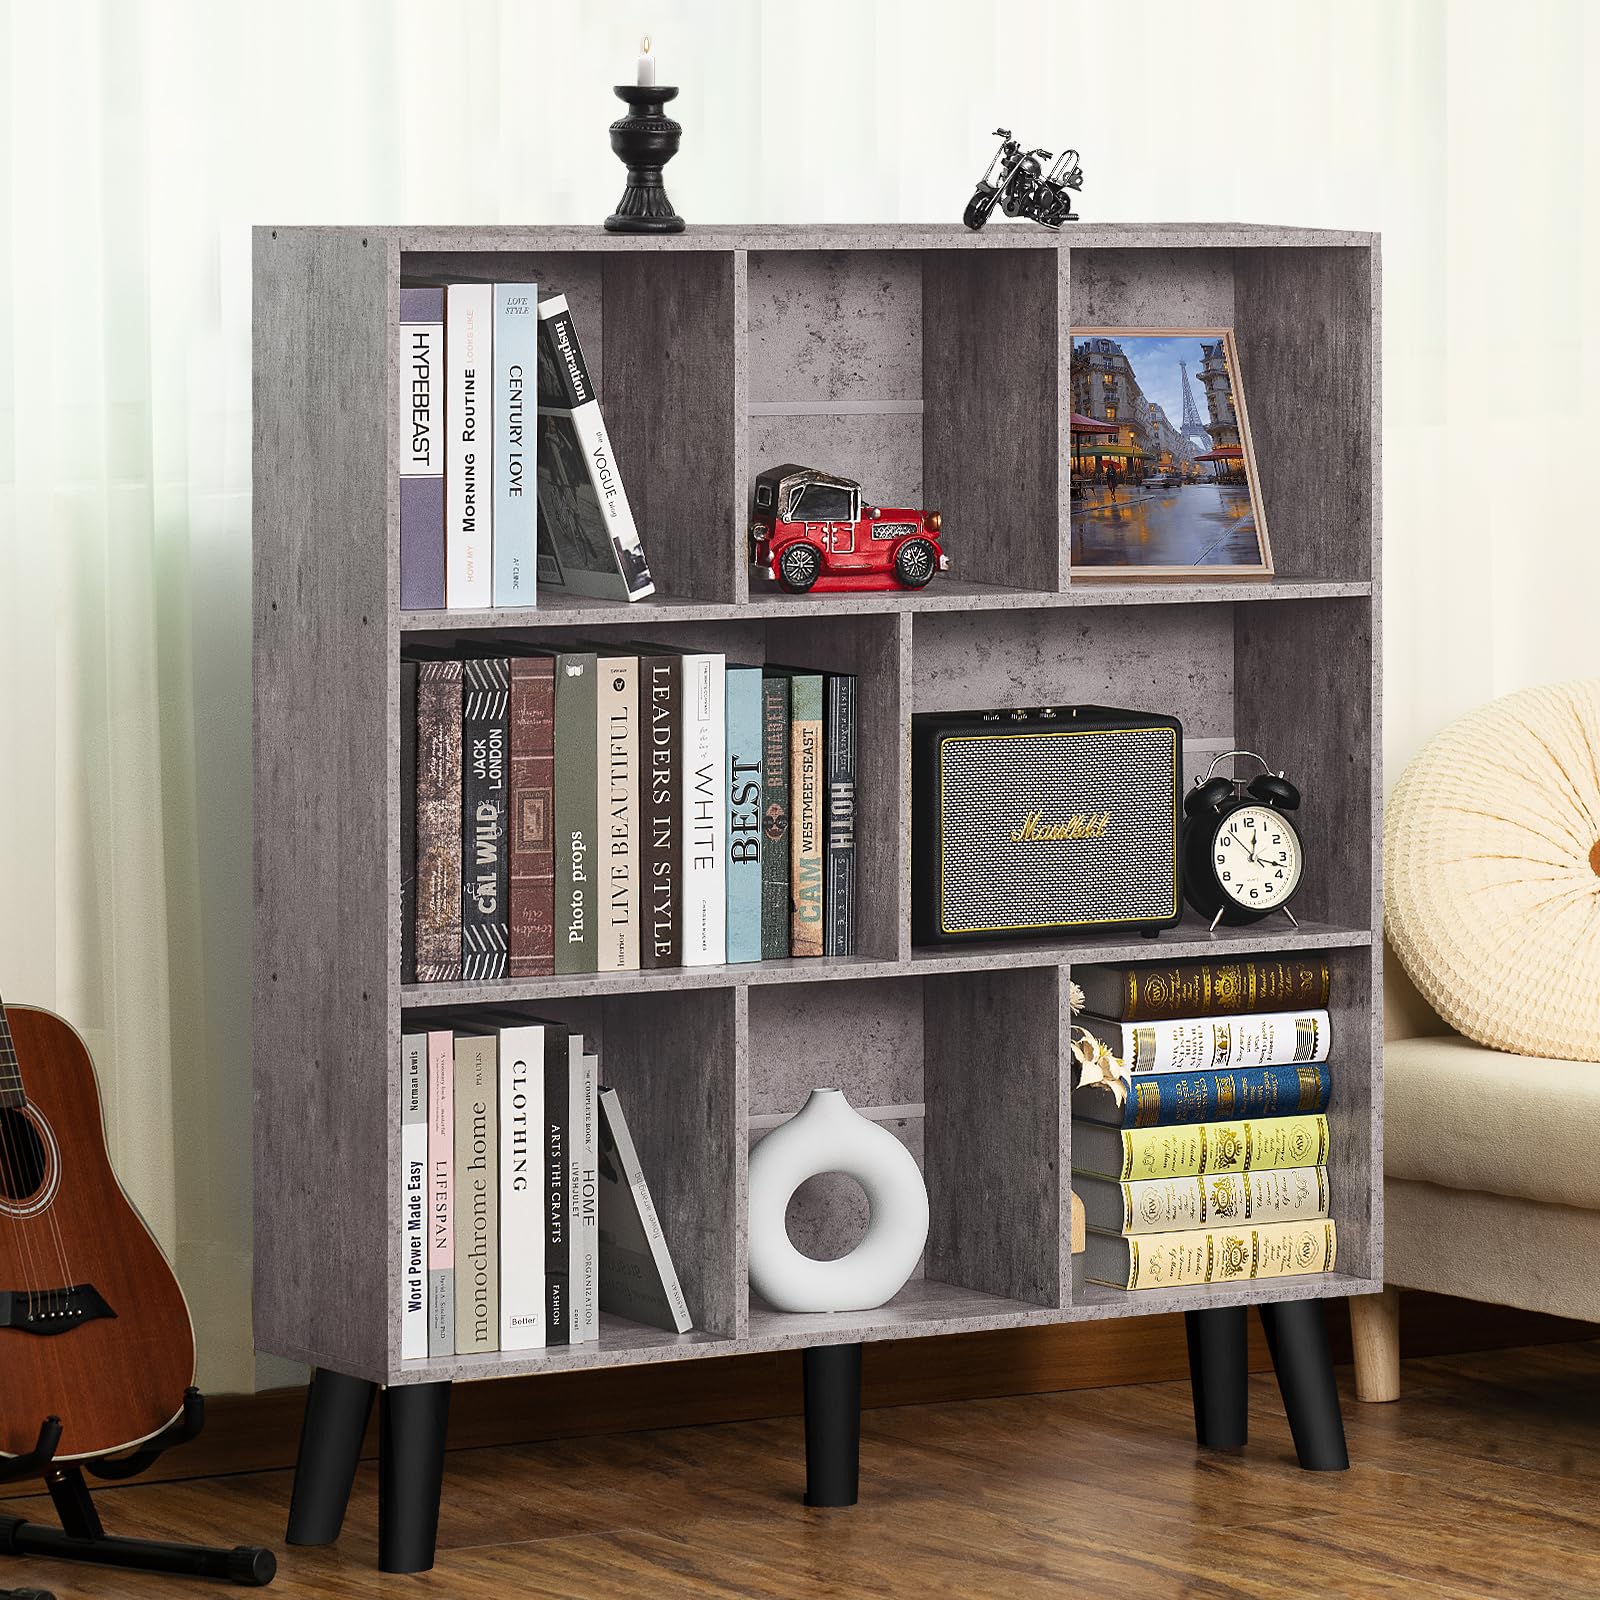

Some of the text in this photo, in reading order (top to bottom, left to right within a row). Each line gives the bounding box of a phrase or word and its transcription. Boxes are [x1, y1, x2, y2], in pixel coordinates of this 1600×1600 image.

[505, 306, 530, 315] STYLE
[507, 297, 528, 306] LOVE
[466, 329, 474, 364] LOOKS
[554, 320, 587, 402] inspiration
[412, 333, 430, 467] HYPEBEAST
[462, 369, 475, 443] ROUTINE
[509, 365, 523, 497] CENTURY LOVE
[462, 453, 475, 532] MORNING
[593, 431, 618, 519] the VOGUE blog
[473, 739, 486, 780] JACK
[489, 729, 503, 790] LONDON
[476, 804, 498, 865] WILD
[610, 706, 629, 967] Interior LIVE BEAUTIFUL
[652, 666, 672, 957] LEADERS IN STYLE
[693, 763, 715, 871] WHITE
[731, 753, 762, 865] BEST
[799, 728, 822, 923] CAM WESTMEETSEAST
[831, 782, 854, 850] HOTH
[1230, 822, 1238, 833] 11
[1243, 817, 1255, 828] 12
[1263, 821, 1267, 832] 1
[1216, 854, 1225, 865] 9
[1220, 836, 1231, 847] 10
[1271, 834, 1281, 844] 2
[1278, 851, 1287, 862] 3
[476, 872, 498, 914] CAL
[569, 831, 587, 944] Photo props
[1222, 871, 1231, 881] 8
[1235, 883, 1244, 894] 7
[1249, 888, 1259, 899] 6
[1264, 882, 1274, 893] 5
[1274, 869, 1284, 879] 4
[1153, 983, 1161, 1002] RW
[512, 1060, 527, 1192] CLOTHING
[1296, 1135, 1303, 1151] RW
[407, 1050, 424, 1313] Word Power Made Easy Norman Lewis
[435, 1161, 448, 1250] LIFESPAN
[551, 1124, 562, 1244] ARTS THE CRAFTS
[571, 1162, 580, 1218] LIVSHJULET
[582, 1169, 595, 1227] HOME
[1148, 1198, 1157, 1215] RW
[467, 1101, 488, 1342] monochrome home
[633, 1171, 687, 1318] SEASONAL flower arranging
[1303, 1242, 1310, 1259] RW
[552, 1284, 561, 1326] FASHION
[584, 1253, 593, 1325] ORGANIZATION
